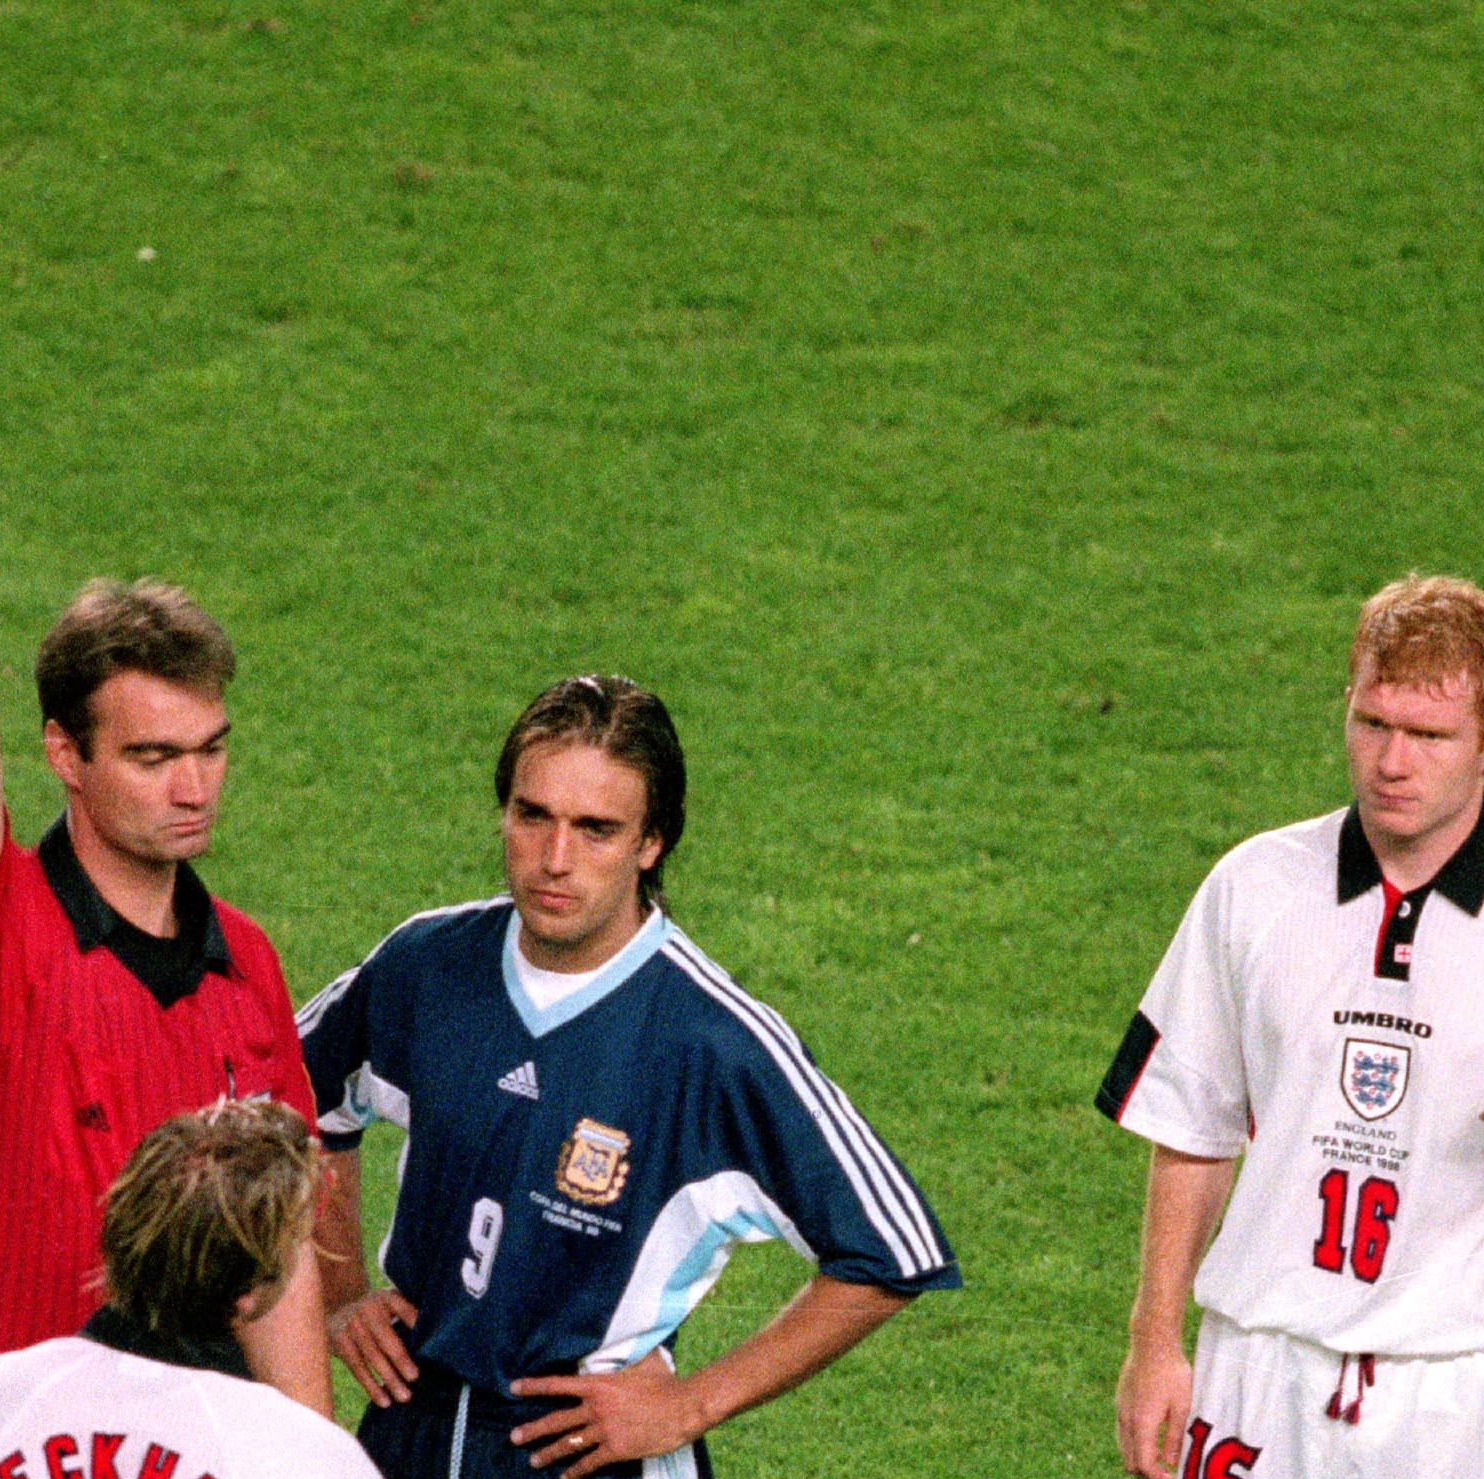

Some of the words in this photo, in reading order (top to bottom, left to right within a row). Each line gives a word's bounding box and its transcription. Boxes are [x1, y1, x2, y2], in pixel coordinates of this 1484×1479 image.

[1333, 1010, 1433, 1038] UMBRO
[1334, 1121, 1397, 1141] ENGLAND
[1312, 1135, 1339, 1147] FIFA
[1342, 1138, 1386, 1155] WORLD
[1389, 1148, 1410, 1160] CUP
[1322, 1148, 1372, 1166] FRANCE
[1313, 1168, 1399, 1284] 16
[461, 1197, 504, 1299] 9
